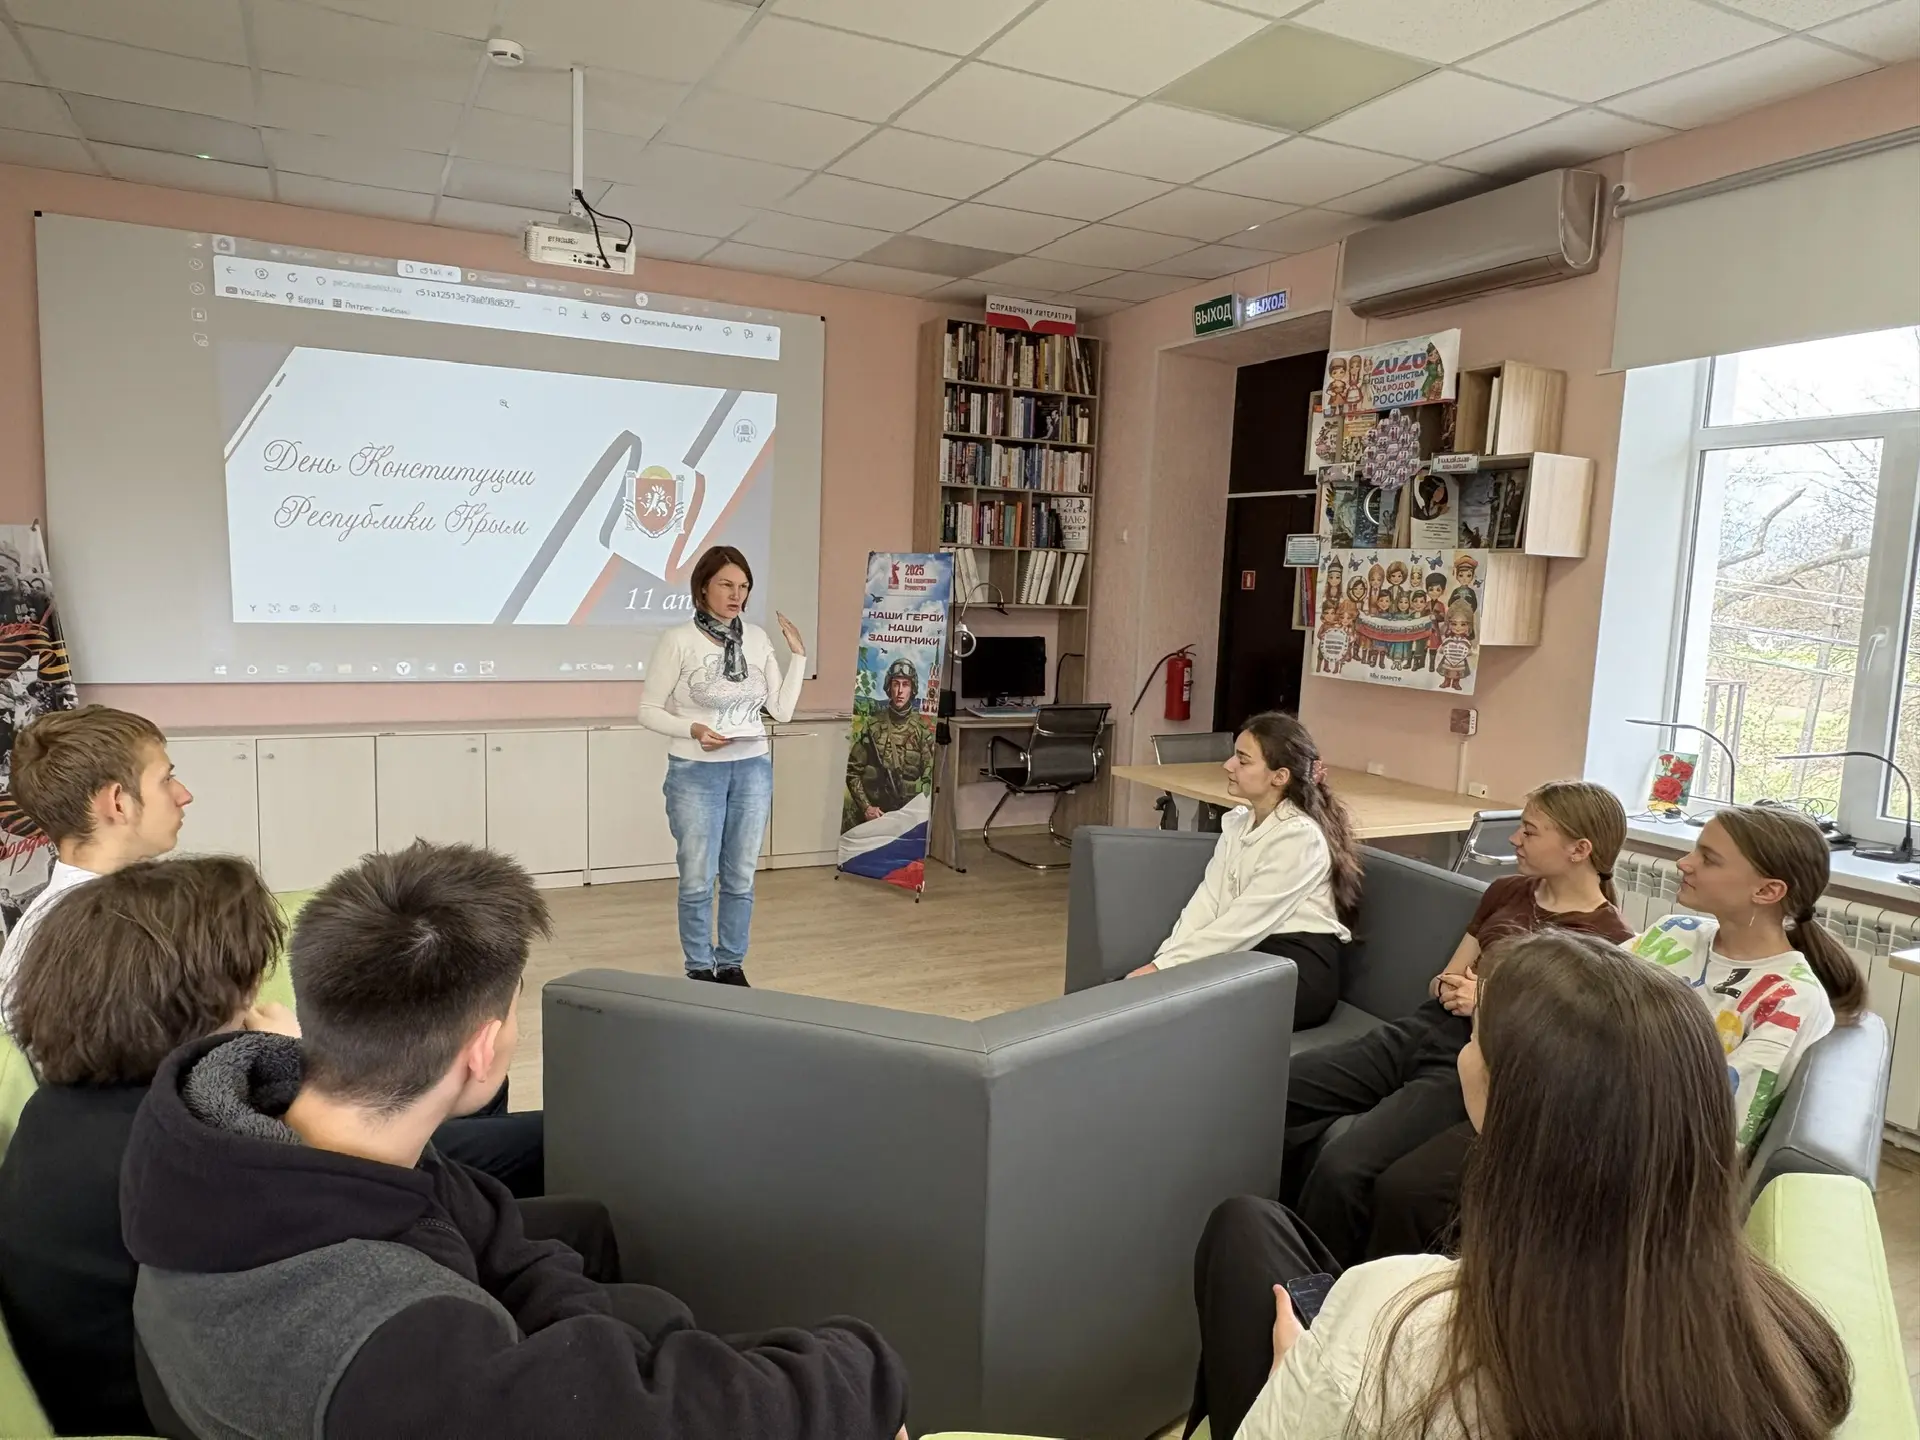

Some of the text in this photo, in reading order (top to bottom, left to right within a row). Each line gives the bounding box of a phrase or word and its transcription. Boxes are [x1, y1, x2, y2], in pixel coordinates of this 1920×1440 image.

[240, 287, 277, 300] YouTube
[989, 302, 1073, 321] СПРАВОЧНАЯ ЛИТЕРАТУРА
[1195, 303, 1232, 326] ВЫХОД
[1370, 370, 1425, 386] ГОД ЕДИНСТВА
[1376, 380, 1415, 393] НАРОДОВ
[1373, 389, 1419, 406] РОССИИ
[263, 439, 536, 496] День Конституции
[274, 495, 529, 546] Республики Крым
[904, 564, 925, 576] 2025
[624, 587, 653, 610] 11
[868, 611, 944, 623] НАШИ ГЕРОИ
[888, 624, 922, 633] НАШИ
